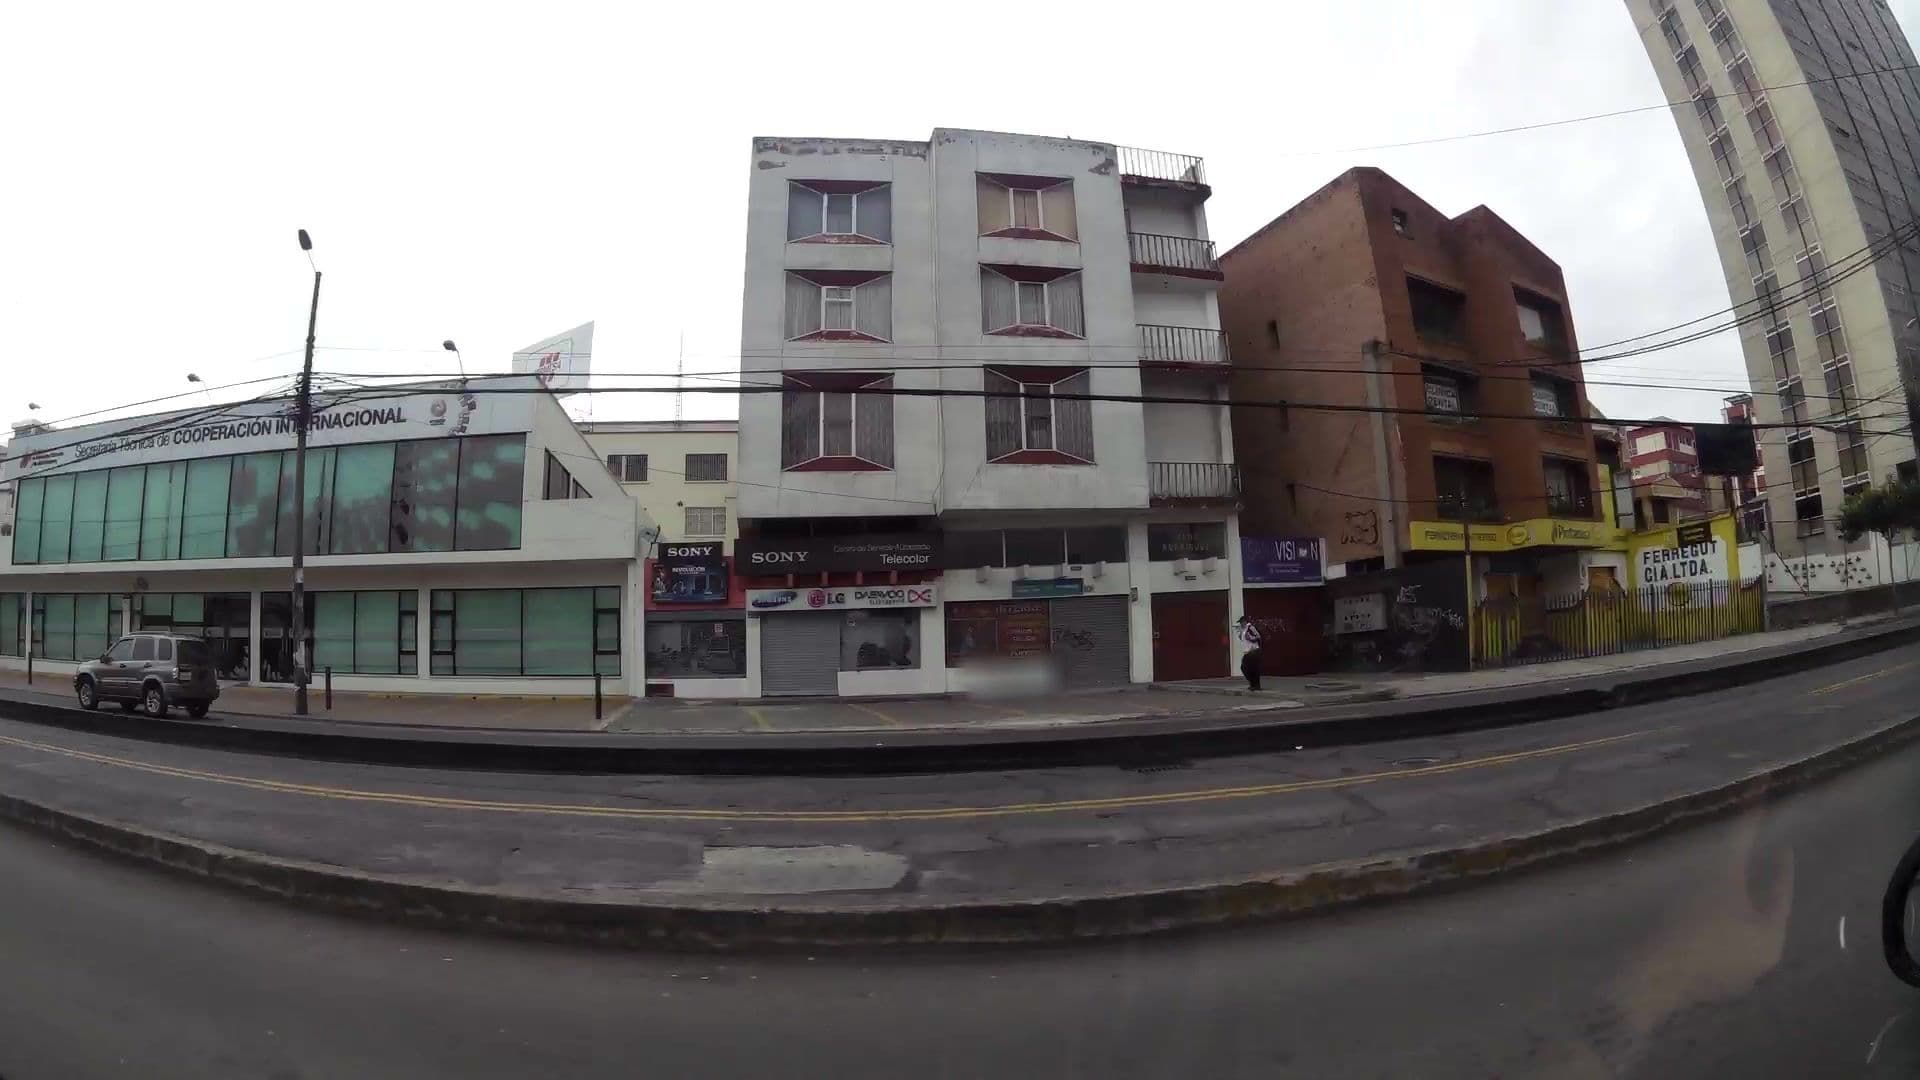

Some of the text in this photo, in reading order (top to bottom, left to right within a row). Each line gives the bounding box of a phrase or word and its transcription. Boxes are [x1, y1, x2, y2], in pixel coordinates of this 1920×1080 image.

[156, 433, 170, 448] de
[173, 417, 272, 446] COOPERACIÓN
[276, 407, 408, 436] INTRNACIONAL
[667, 546, 713, 557] SONY
[751, 551, 809, 564] SONY
[880, 553, 931, 565] Telecolor
[827, 592, 846, 605] LG
